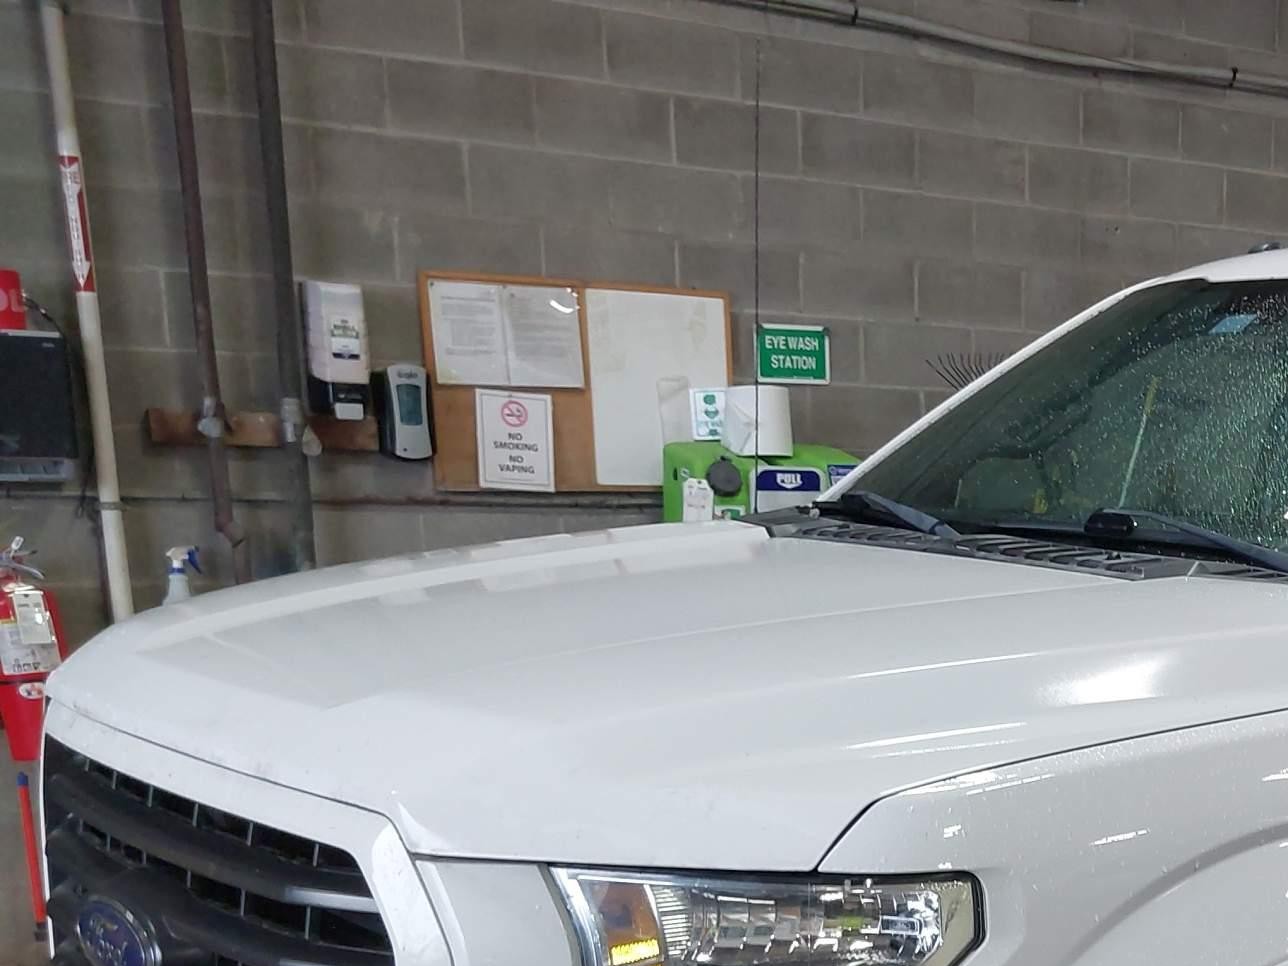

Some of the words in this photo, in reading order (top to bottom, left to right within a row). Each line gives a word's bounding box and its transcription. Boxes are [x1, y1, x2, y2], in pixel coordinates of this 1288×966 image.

[765, 335, 786, 349] EYE
[787, 336, 819, 350] WASH
[771, 354, 816, 370] STATION
[508, 432, 523, 441] NO
[493, 441, 538, 452] SMOKING
[509, 455, 524, 464] NO
[498, 464, 535, 474] VAPING
